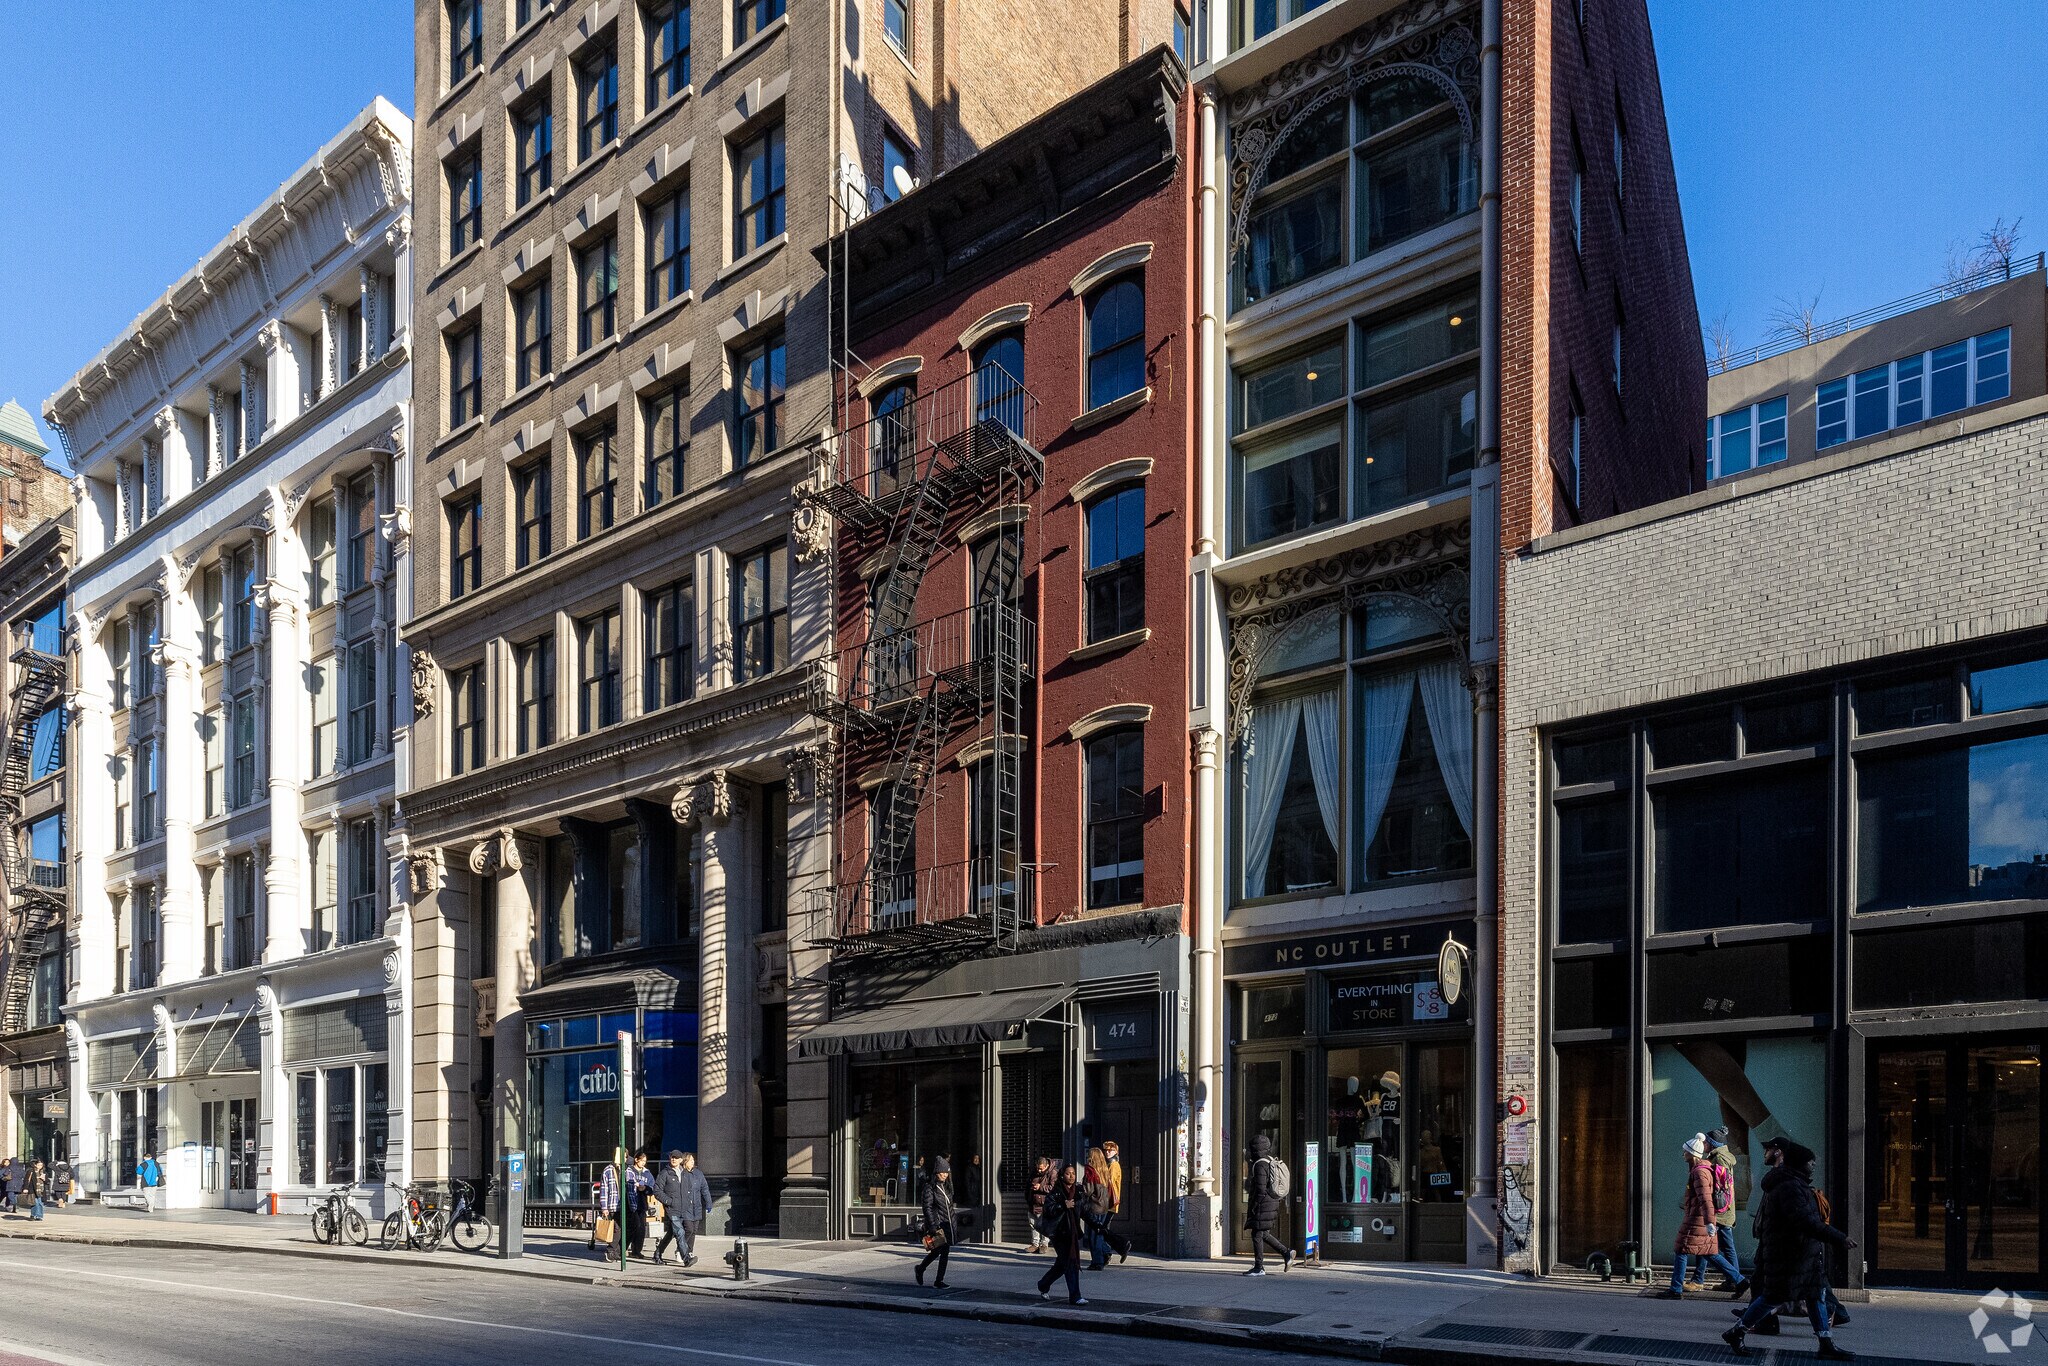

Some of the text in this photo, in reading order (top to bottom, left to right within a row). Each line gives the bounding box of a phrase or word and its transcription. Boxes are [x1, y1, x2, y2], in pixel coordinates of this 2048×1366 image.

[1276, 934, 1411, 963] NC OUTLET
[1337, 983, 1412, 998] EVERYTHING
[1370, 999, 1378, 1007] IN
[1352, 1007, 1396, 1020] STORE
[1108, 1022, 1136, 1038] 474
[1382, 1100, 1397, 1111] 28
[1431, 1174, 1450, 1184] OPEN
